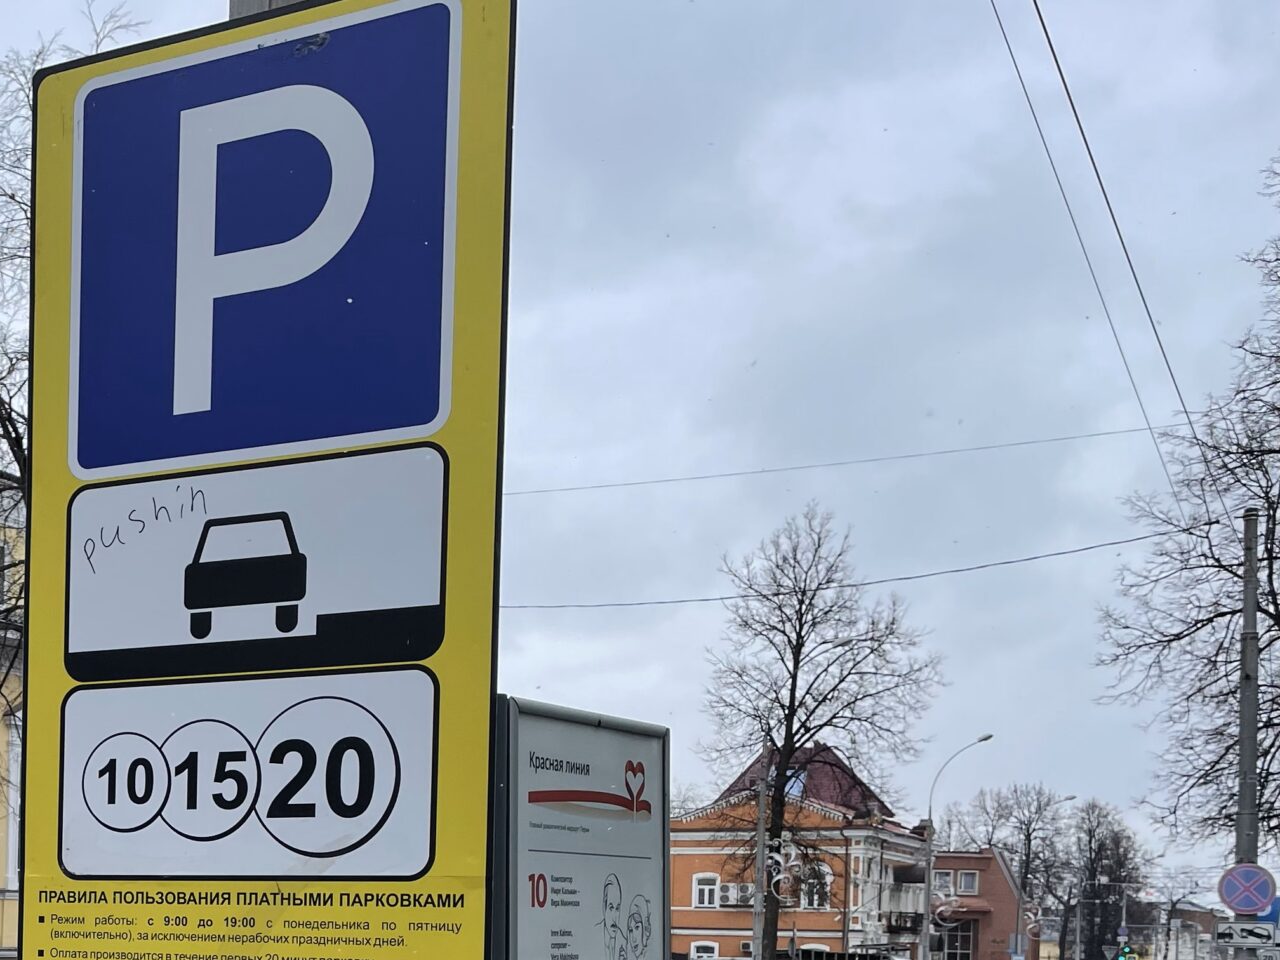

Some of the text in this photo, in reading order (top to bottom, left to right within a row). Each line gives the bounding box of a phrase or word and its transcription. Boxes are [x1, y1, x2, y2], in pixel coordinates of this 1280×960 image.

[173, 84, 375, 416] P
[529, 751, 590, 776] Красная линия
[97, 736, 375, 819] 10 15 20
[38, 889, 464, 908] ПРАВИЛА ПОЛЬЗОВАНИЯ ПЛАТНЫМИ ПАРКОВКАМИ
[528, 873, 548, 908] 10
[50, 912, 462, 935] Режим работы: с 9:00 до 19:00 с понедельника по пятницу
[49, 927, 407, 948] (включительно), за исключением нерабочих праздничных дней.
[49, 946, 88, 959] Оплата
